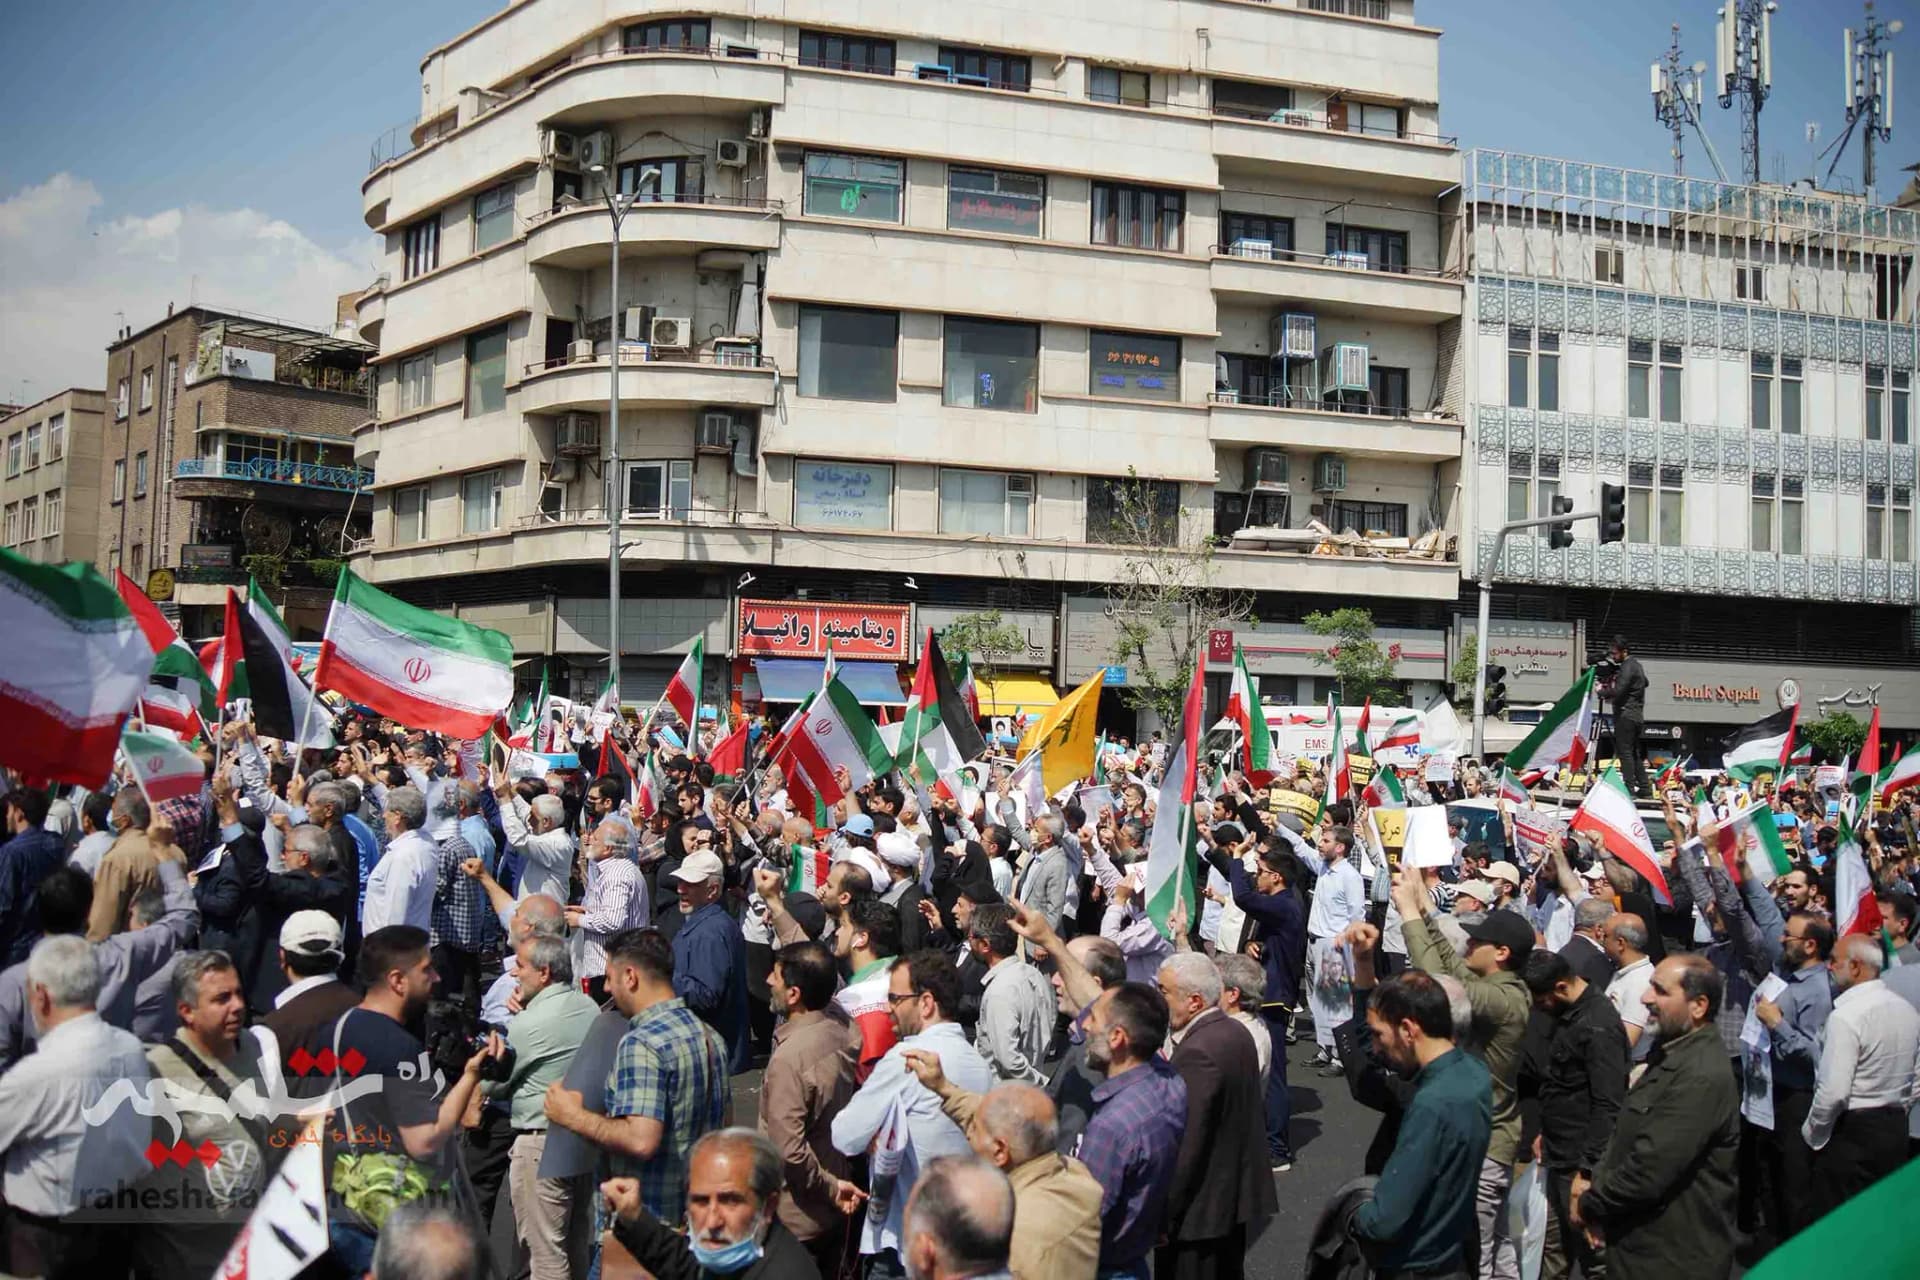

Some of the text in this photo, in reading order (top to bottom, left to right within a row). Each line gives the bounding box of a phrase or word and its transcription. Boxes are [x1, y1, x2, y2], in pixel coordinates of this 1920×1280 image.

[812, 466, 872, 489] دفترخانه
[743, 612, 811, 646] وانیلا
[822, 615, 896, 648] ویتامینه
[1511, 645, 1540, 657] فرهنگی
[1673, 683, 1760, 705] Bank Sepah
[1304, 738, 1328, 749] EMS
